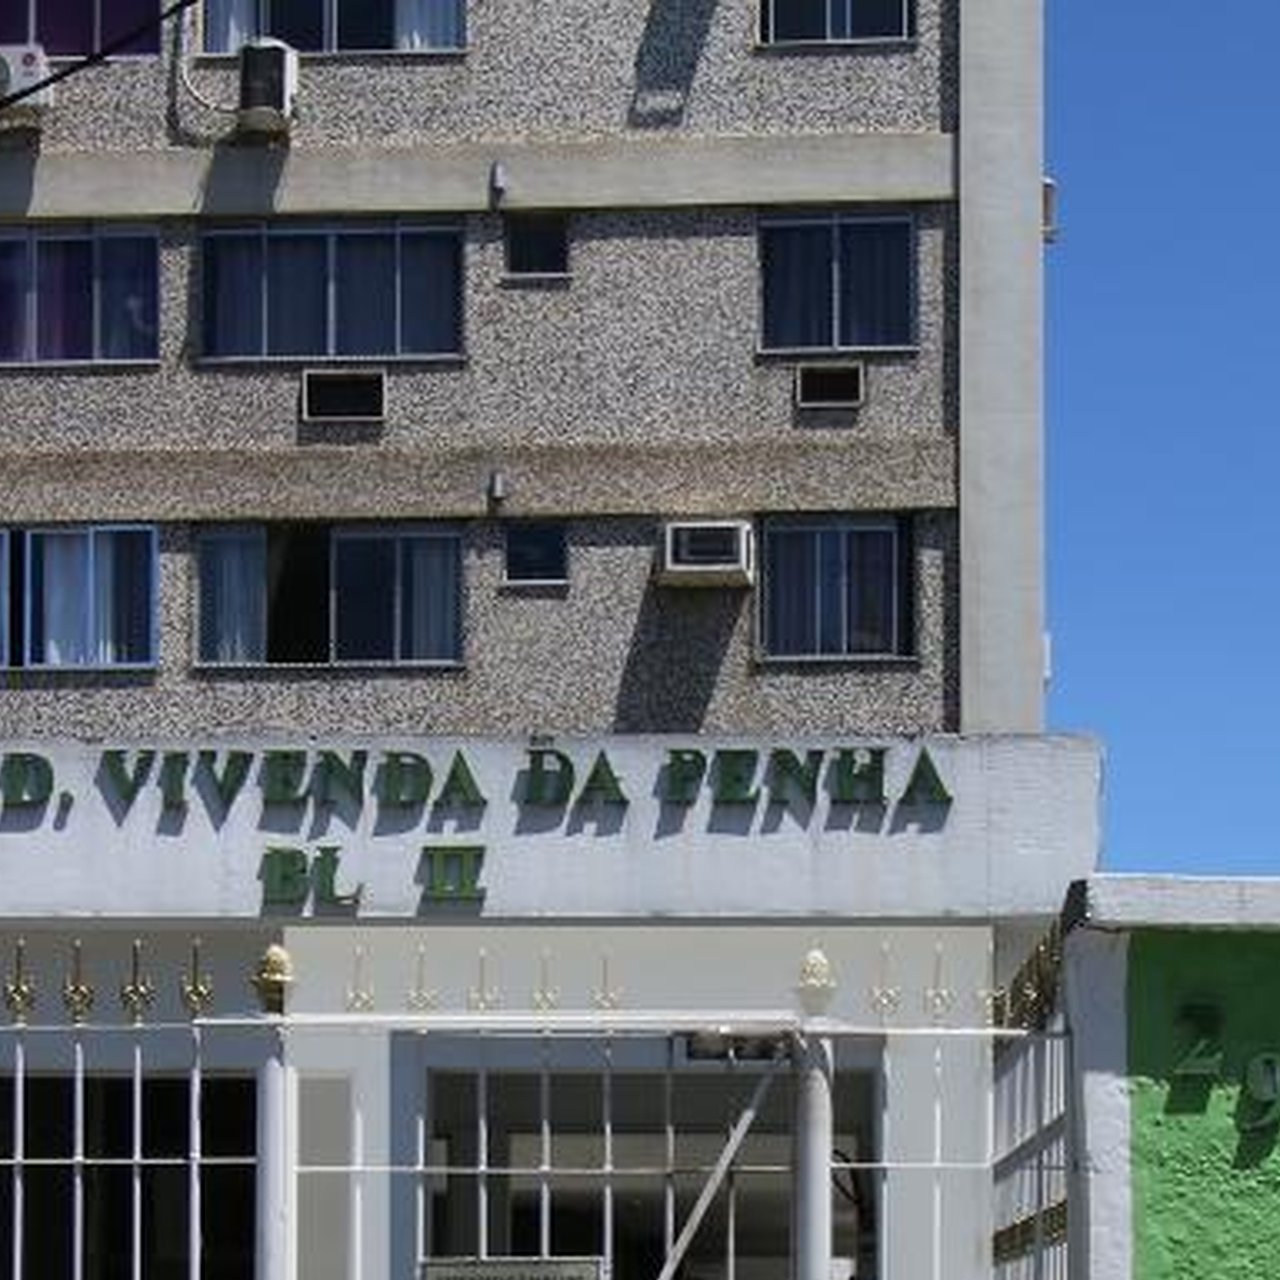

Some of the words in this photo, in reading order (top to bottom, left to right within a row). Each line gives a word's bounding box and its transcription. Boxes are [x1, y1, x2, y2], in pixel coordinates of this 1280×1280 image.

[97, 748, 488, 811] VIVENDA
[520, 748, 630, 811] DA
[662, 748, 953, 811] PENHA
[262, 845, 362, 902] BL
